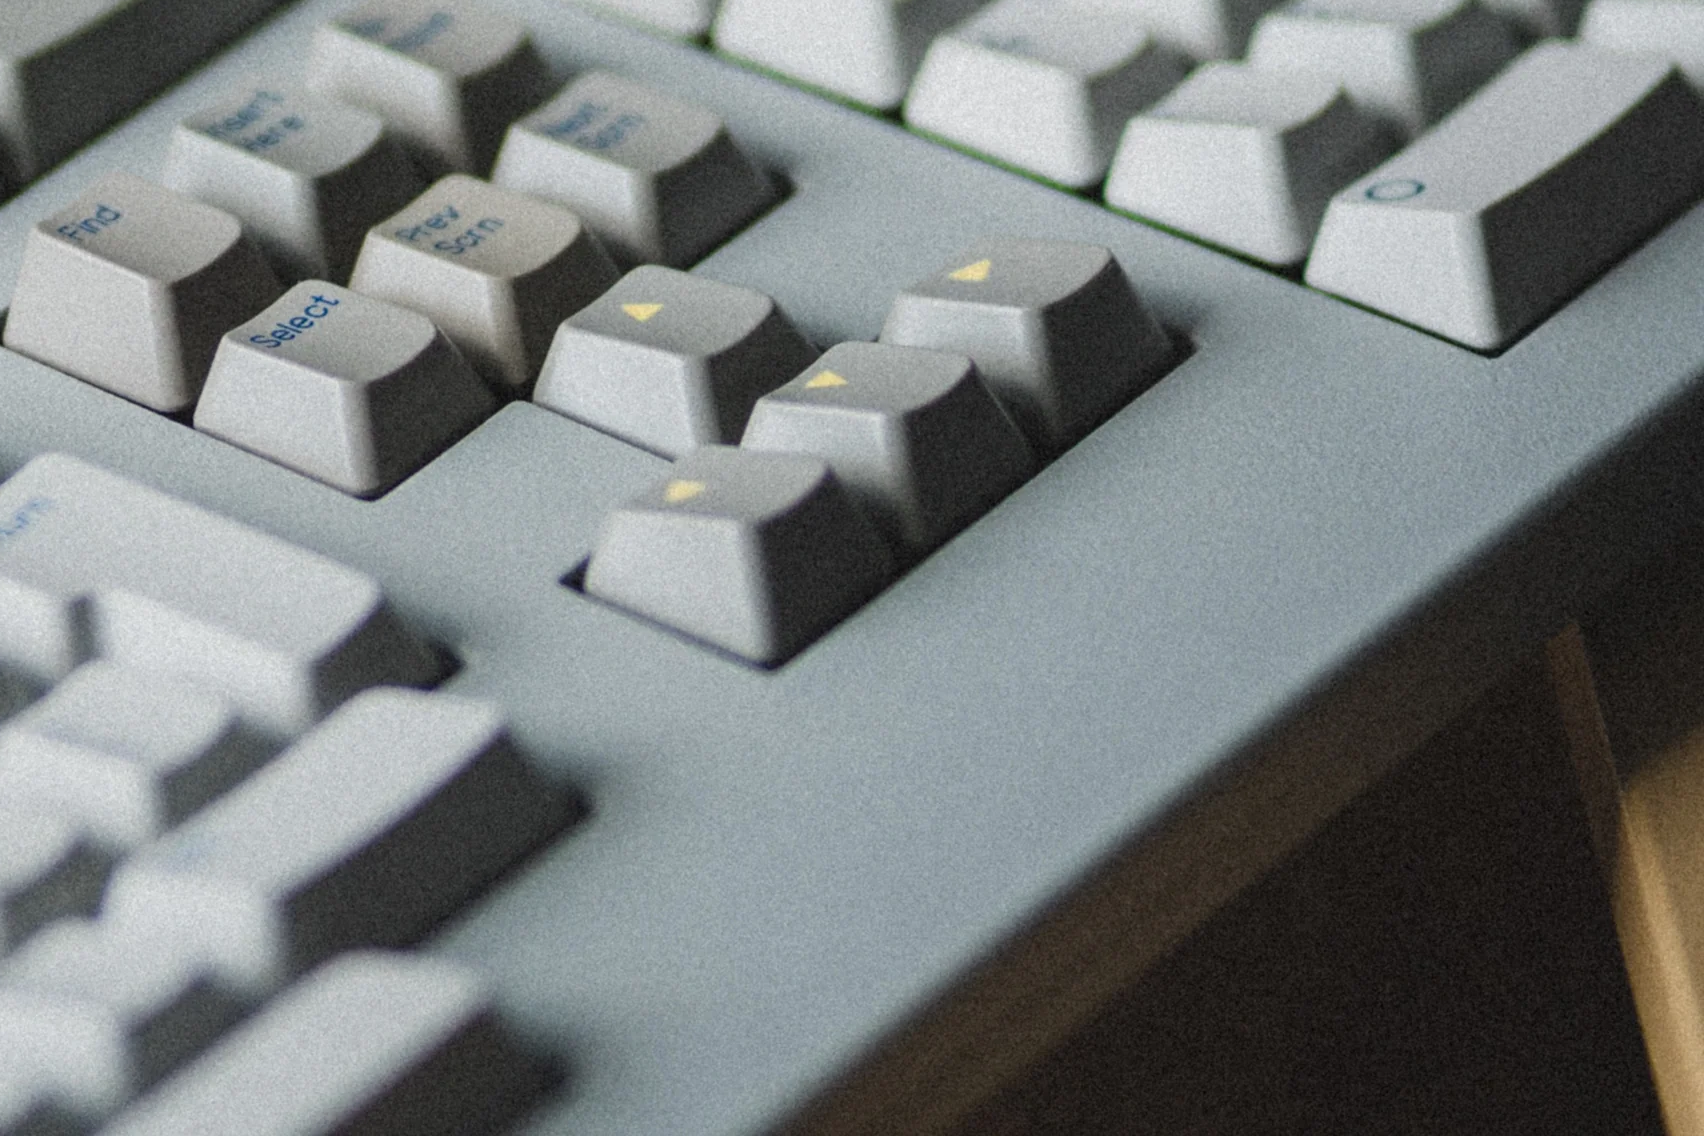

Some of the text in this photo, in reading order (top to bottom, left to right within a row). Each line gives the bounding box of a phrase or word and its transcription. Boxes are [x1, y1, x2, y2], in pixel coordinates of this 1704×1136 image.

[56, 204, 123, 242] Find
[394, 204, 461, 243] Prev
[433, 217, 505, 255] Scrn
[249, 294, 341, 350] Select
